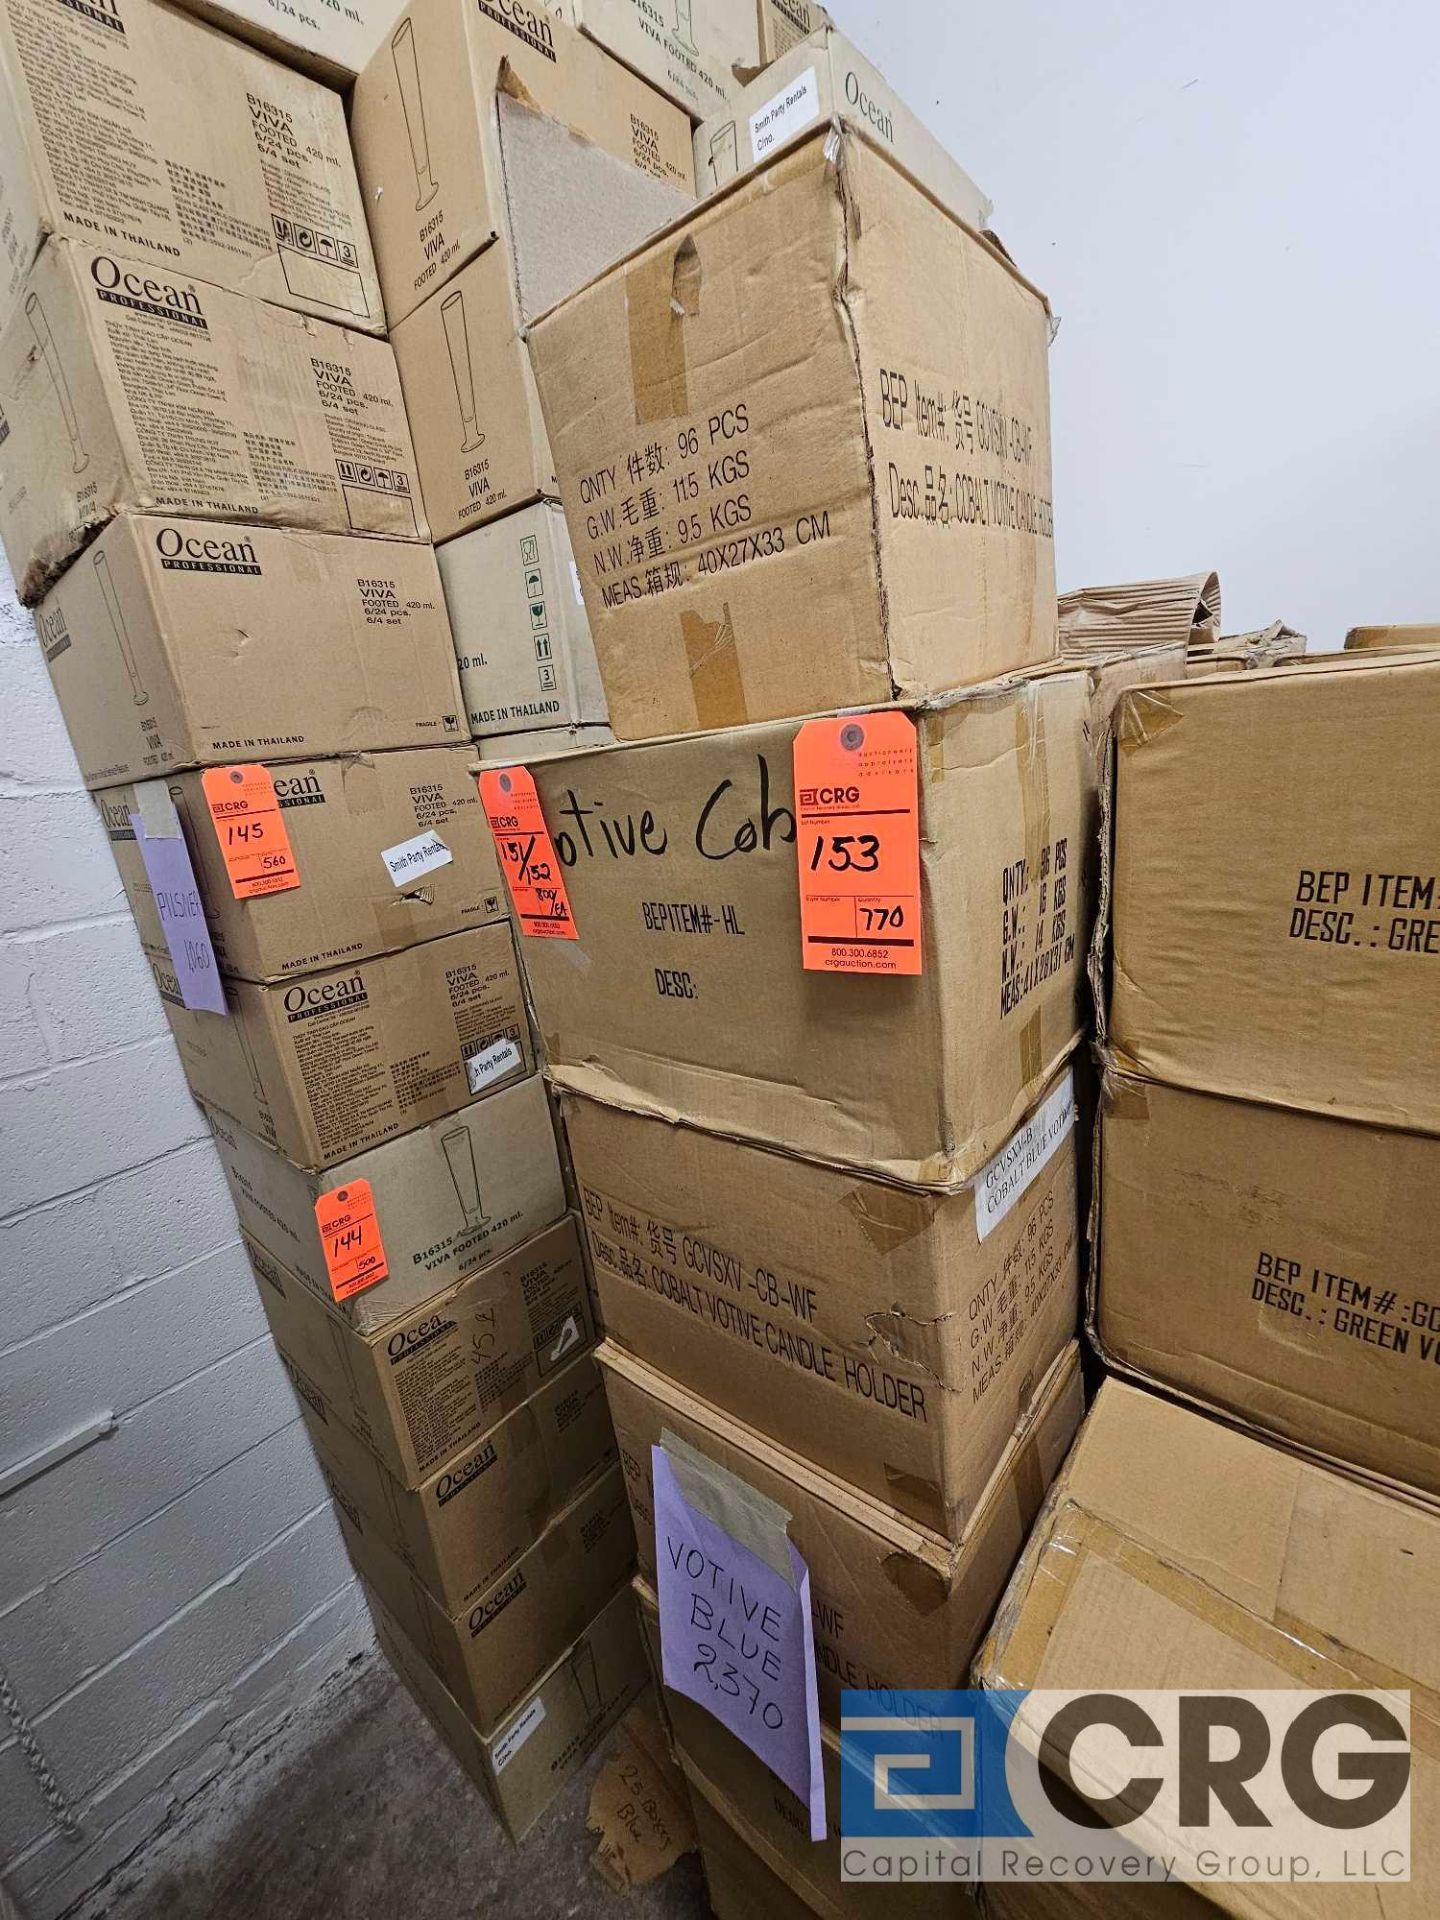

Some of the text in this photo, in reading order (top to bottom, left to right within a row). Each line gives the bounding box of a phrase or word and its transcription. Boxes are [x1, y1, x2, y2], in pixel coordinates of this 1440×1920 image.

[299, 13, 321, 31] pcs.
[490, 0, 554, 48] cean
[638, 17, 662, 47] VIVA
[698, 70, 713, 88] 420
[246, 92, 293, 124] B16315
[249, 105, 293, 137] VIVA
[753, 84, 808, 134] Smith Party Rentals
[844, 71, 895, 145] Ocean
[252, 119, 324, 161] FOOTED 420
[254, 131, 283, 150] 6/24
[257, 143, 278, 159] 6/4
[631, 124, 659, 152] VIVA
[63, 211, 181, 257] MADE IN THAILAND
[419, 210, 444, 243] B16315
[422, 232, 445, 261] VIVA
[414, 247, 452, 290] FOOTED 420
[90, 255, 205, 316] Ocean
[96, 287, 209, 330] PROFESSIONAL
[310, 357, 353, 377] B16315
[313, 369, 354, 388] VIVA
[315, 380, 377, 405] FOOTED 420
[318, 389, 345, 403] 6/24
[321, 399, 340, 410] 6/4
[879, 367, 908, 431] BEP
[464, 458, 490, 480] B16315
[579, 465, 617, 504] QNTY
[678, 427, 700, 459] 96
[708, 403, 750, 446] PCS
[707, 450, 751, 490] KGS
[468, 476, 491, 500] VIVA
[955, 472, 990, 528] COBALT
[156, 496, 259, 515] MADE IN THAILAND
[458, 491, 497, 521] FOOTED 420
[677, 513, 702, 545] 9.5
[710, 494, 752, 532] KGS
[155, 528, 259, 564] Ocean
[697, 526, 786, 577] 40X27X33
[796, 510, 831, 546] CM
[160, 558, 262, 576] PROFESSIONAL
[357, 578, 396, 590] B16315
[359, 588, 397, 600] VIVA
[362, 598, 421, 611] FOOTED 420
[364, 606, 387, 616] 6/24
[366, 616, 402, 626] 6/4 set
[471, 654, 488, 667] ml.
[470, 700, 560, 725] MADE IN THAILAND
[212, 735, 305, 750] MADE IN THAILAND
[273, 774, 322, 800] ean
[409, 783, 444, 796] B16315
[412, 792, 445, 805] VIVA
[819, 785, 861, 805] CRG
[224, 800, 249, 812] CRG
[414, 798, 466, 813] FOOTED 420
[416, 810, 437, 820] 6/24
[554, 753, 798, 867] otive Cob
[228, 822, 264, 846] 145
[417, 819, 435, 828] 6/4
[500, 815, 519, 829] CRG
[263, 855, 286, 869] 560
[389, 850, 425, 874] Smith Party
[810, 834, 881, 873] 153
[1002, 837, 1069, 906] QNTY: PCS
[1053, 875, 1067, 913] KGS
[1296, 870, 1440, 911] BEP ITEM
[721, 904, 746, 936] HL
[859, 904, 905, 932] 770
[1051, 908, 1066, 944] KGS
[281, 942, 363, 971] MADE IN THAILAND
[825, 957, 897, 970] crgauction.com
[831, 947, 889, 960] 800.300.6852
[445, 964, 478, 979] B16315
[447, 972, 477, 987] VIVA
[448, 979, 480, 994] FOOTED
[654, 967, 699, 1000] DESC:
[283, 974, 366, 1014] Ocean
[287, 992, 369, 1024] PROFESSIONAL
[478, 1046, 513, 1077] Party Rentals
[323, 1122, 400, 1160] MADE IN THAILAND
[987, 1133, 1048, 1214] COBALT BLUE
[331, 1214, 351, 1229] CRG
[1038, 1218, 1054, 1251] KGS
[334, 1224, 362, 1258] 144
[412, 1237, 454, 1266] B16315
[424, 1251, 451, 1271] VIVA
[451, 1229, 490, 1257] FOOTED
[490, 1216, 509, 1234] 420
[968, 1195, 1054, 1322] QNTY 96 PCS
[1256, 1250, 1302, 1286] BEP
[386, 1313, 445, 1358] Ocea
[651, 1265, 704, 1320] COBALT
[706, 1289, 764, 1348] VOTIVE
[765, 1320, 836, 1383] CANDLE
[842, 1355, 928, 1423] HOLDER
[1333, 1307, 1411, 1355] GREEN
[418, 1422, 482, 1473] MADE THAILAND
[435, 1440, 498, 1500] Ocean
[468, 1569, 526, 1632] Ocean
[667, 1535, 782, 1642] VOTIVE
[690, 1592, 783, 1681] BLUE
[815, 1638, 860, 1690] NDLE
[693, 1643, 784, 1730] 2,370
